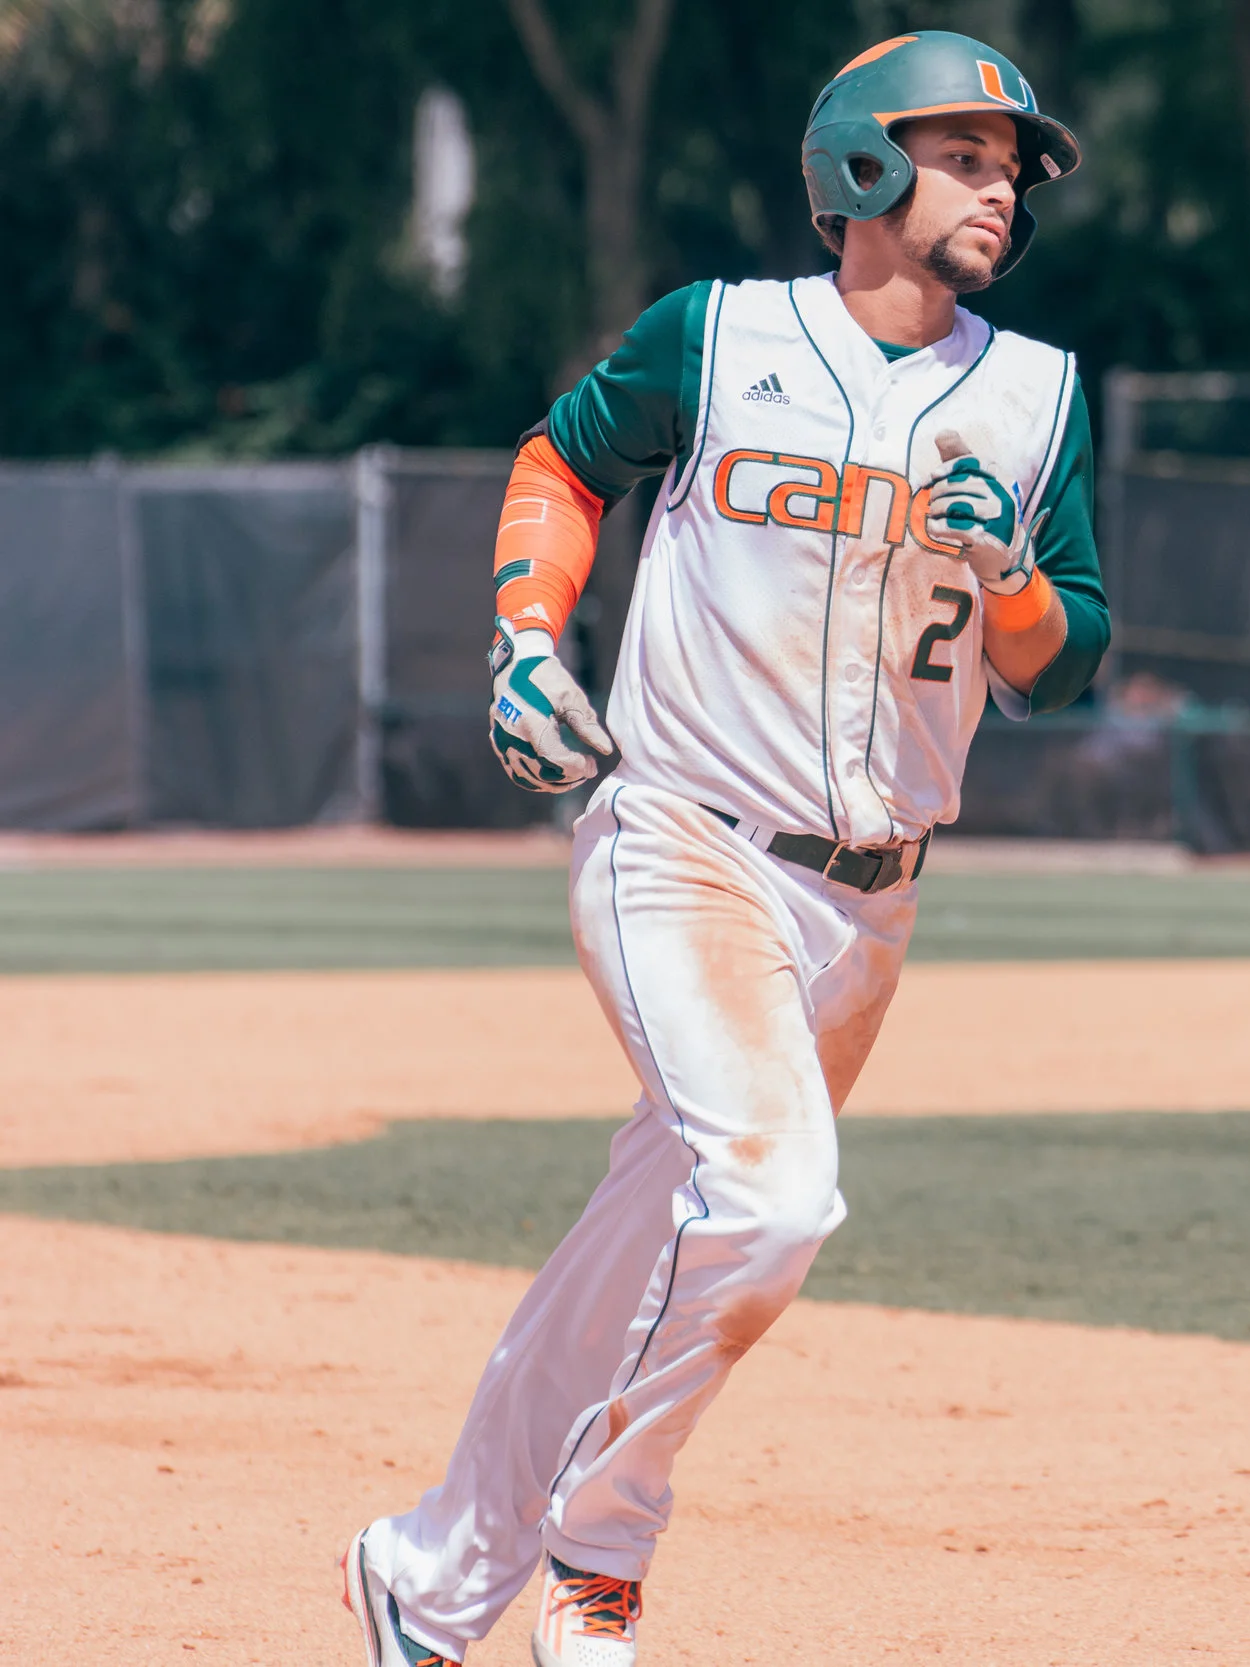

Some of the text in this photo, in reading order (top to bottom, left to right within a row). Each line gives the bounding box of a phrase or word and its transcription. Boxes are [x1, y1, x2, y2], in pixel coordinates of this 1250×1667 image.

[976, 59, 1038, 114] U
[742, 389, 790, 405] adidas
[910, 583, 973, 683] 2
